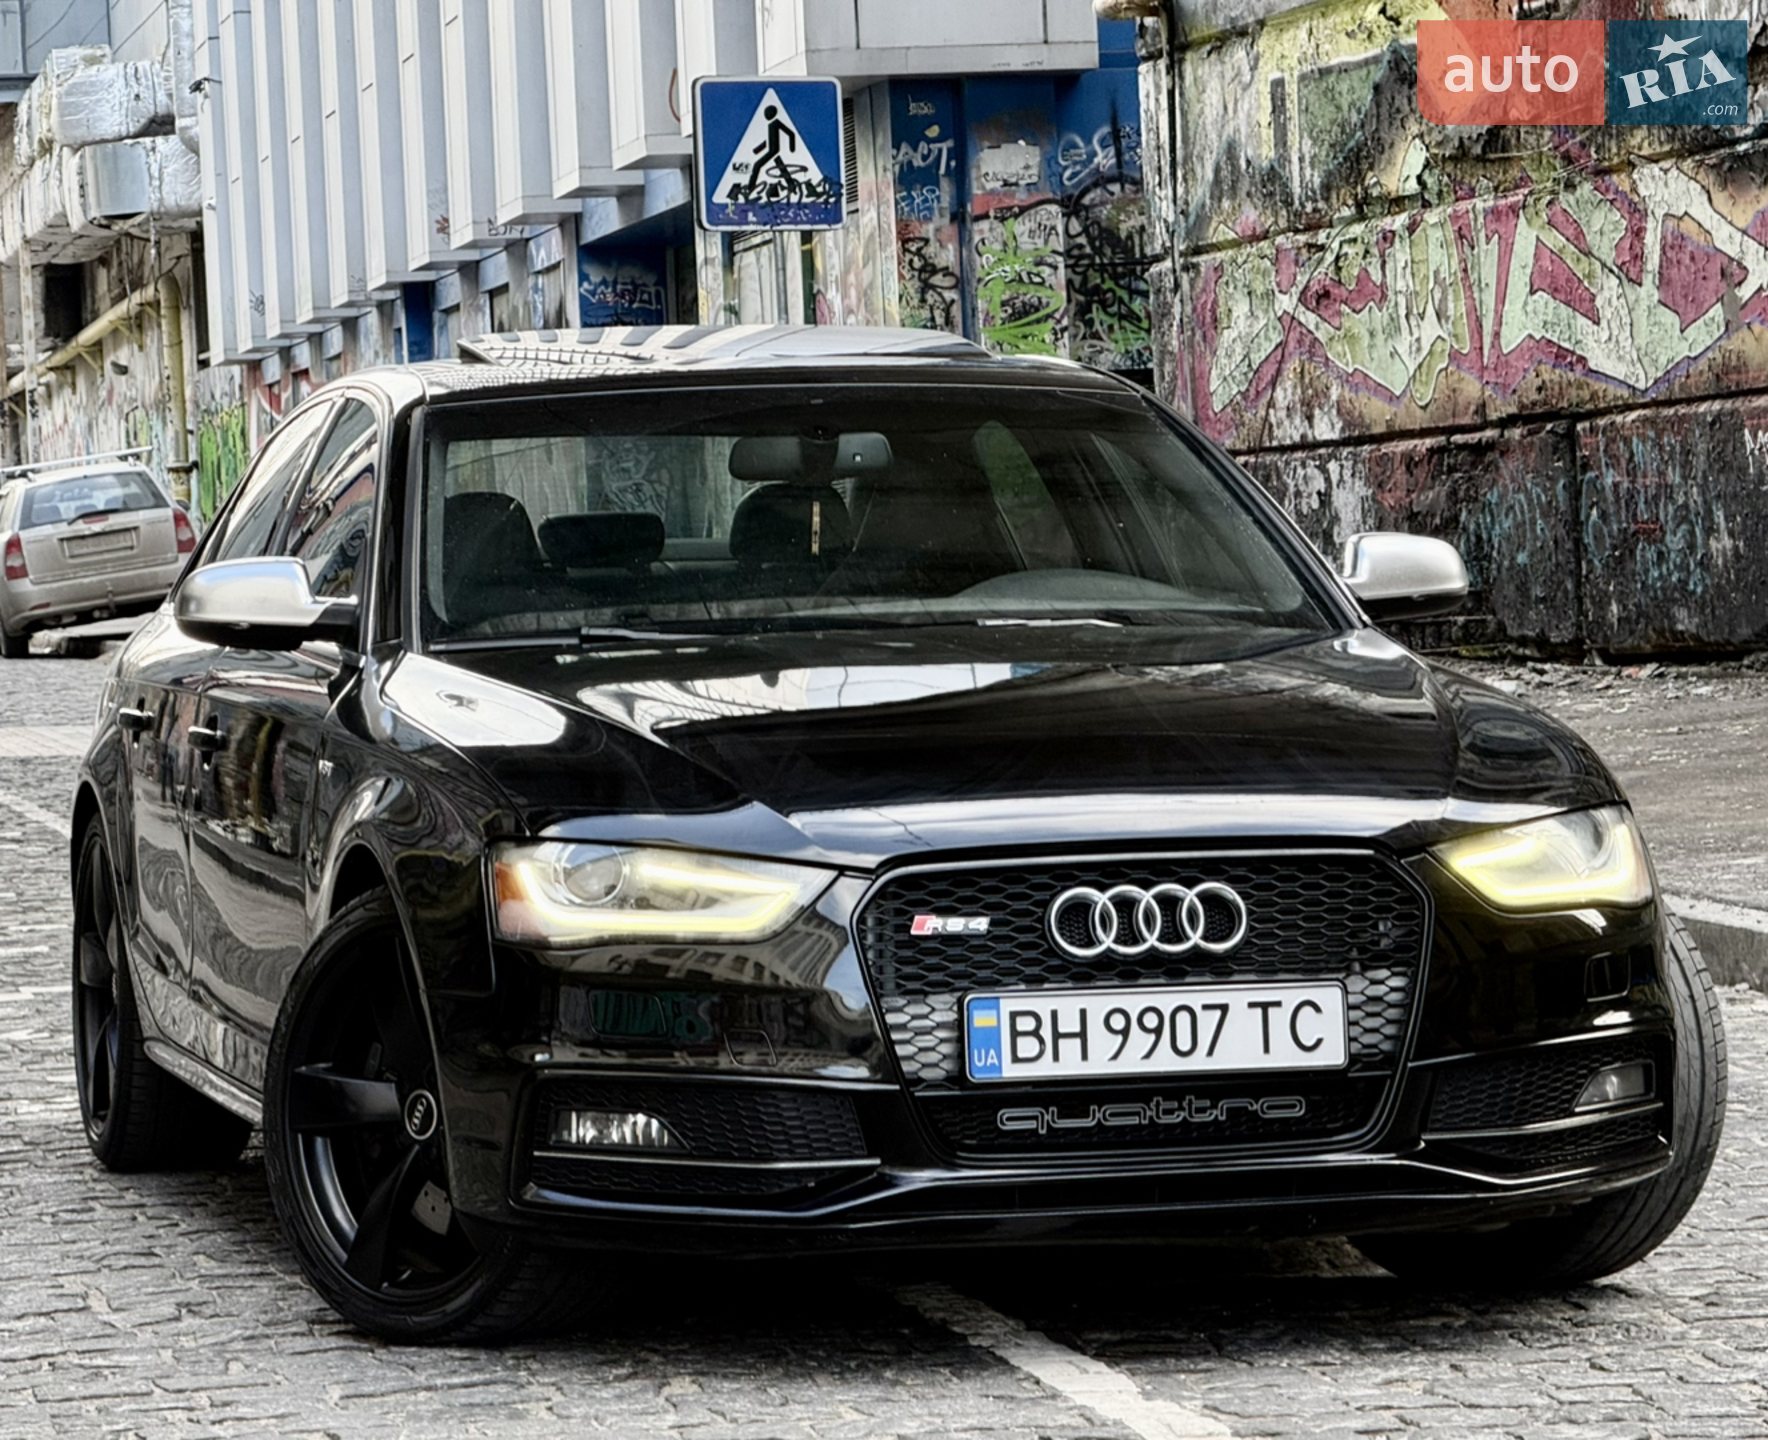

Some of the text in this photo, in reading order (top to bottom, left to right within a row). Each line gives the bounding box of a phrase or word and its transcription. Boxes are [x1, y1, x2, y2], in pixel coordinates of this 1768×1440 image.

[918, 916, 990, 934] RS4
[1009, 999, 1324, 1065] BH 9907 TC
[973, 1048, 999, 1067] UA
[997, 1095, 1305, 1134] quattro
